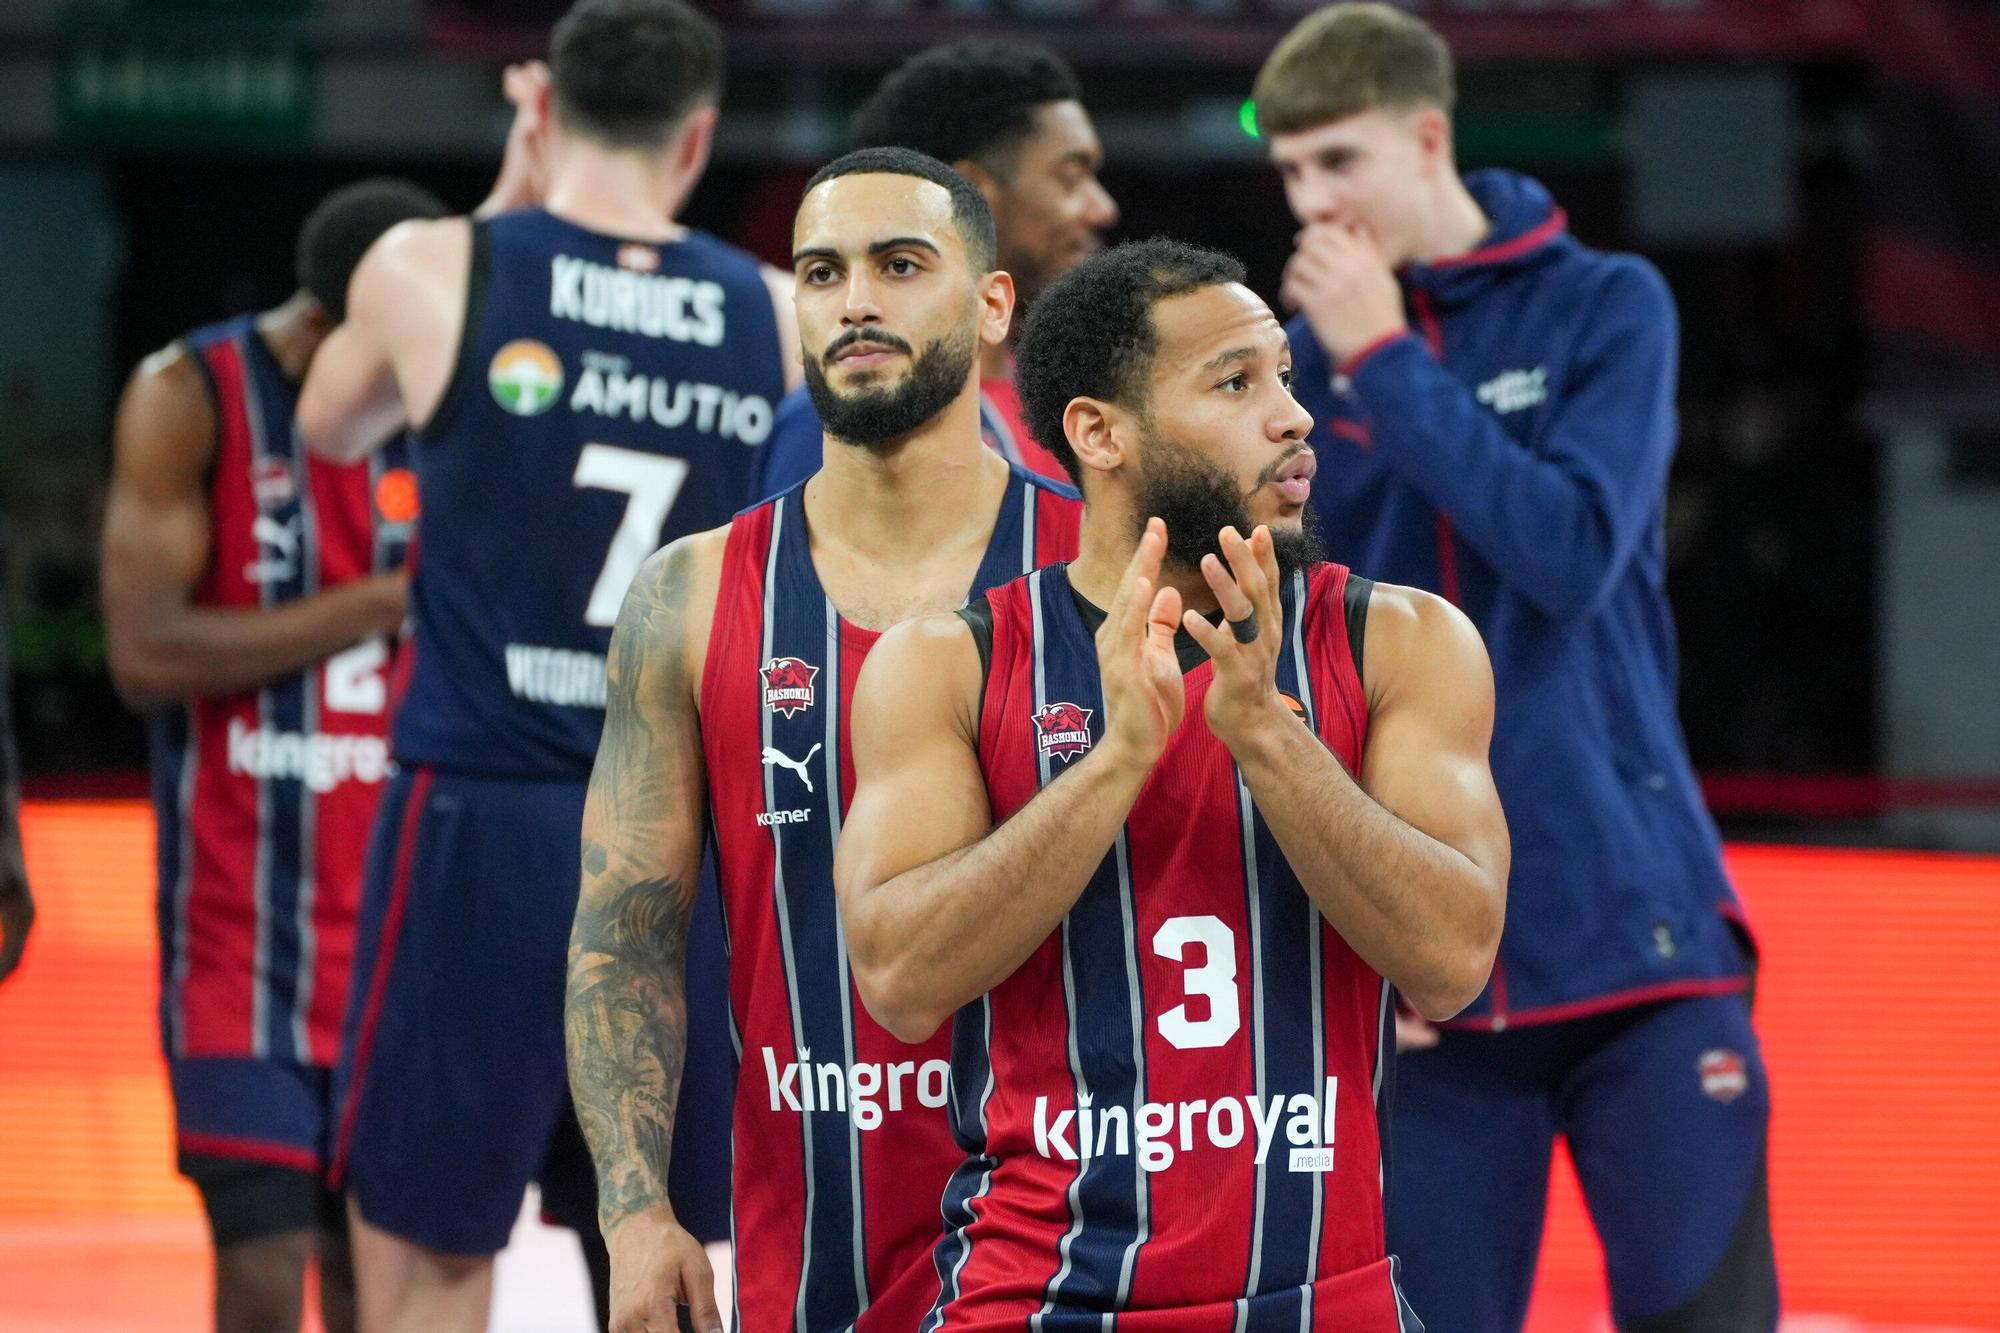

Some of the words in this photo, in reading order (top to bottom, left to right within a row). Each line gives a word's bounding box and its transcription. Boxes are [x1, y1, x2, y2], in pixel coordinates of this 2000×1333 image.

[569, 366, 774, 446] AMUTIO
[573, 443, 689, 626] 7
[1152, 914, 1241, 1050] 3
[1033, 1075, 1337, 1171] kingroyal
